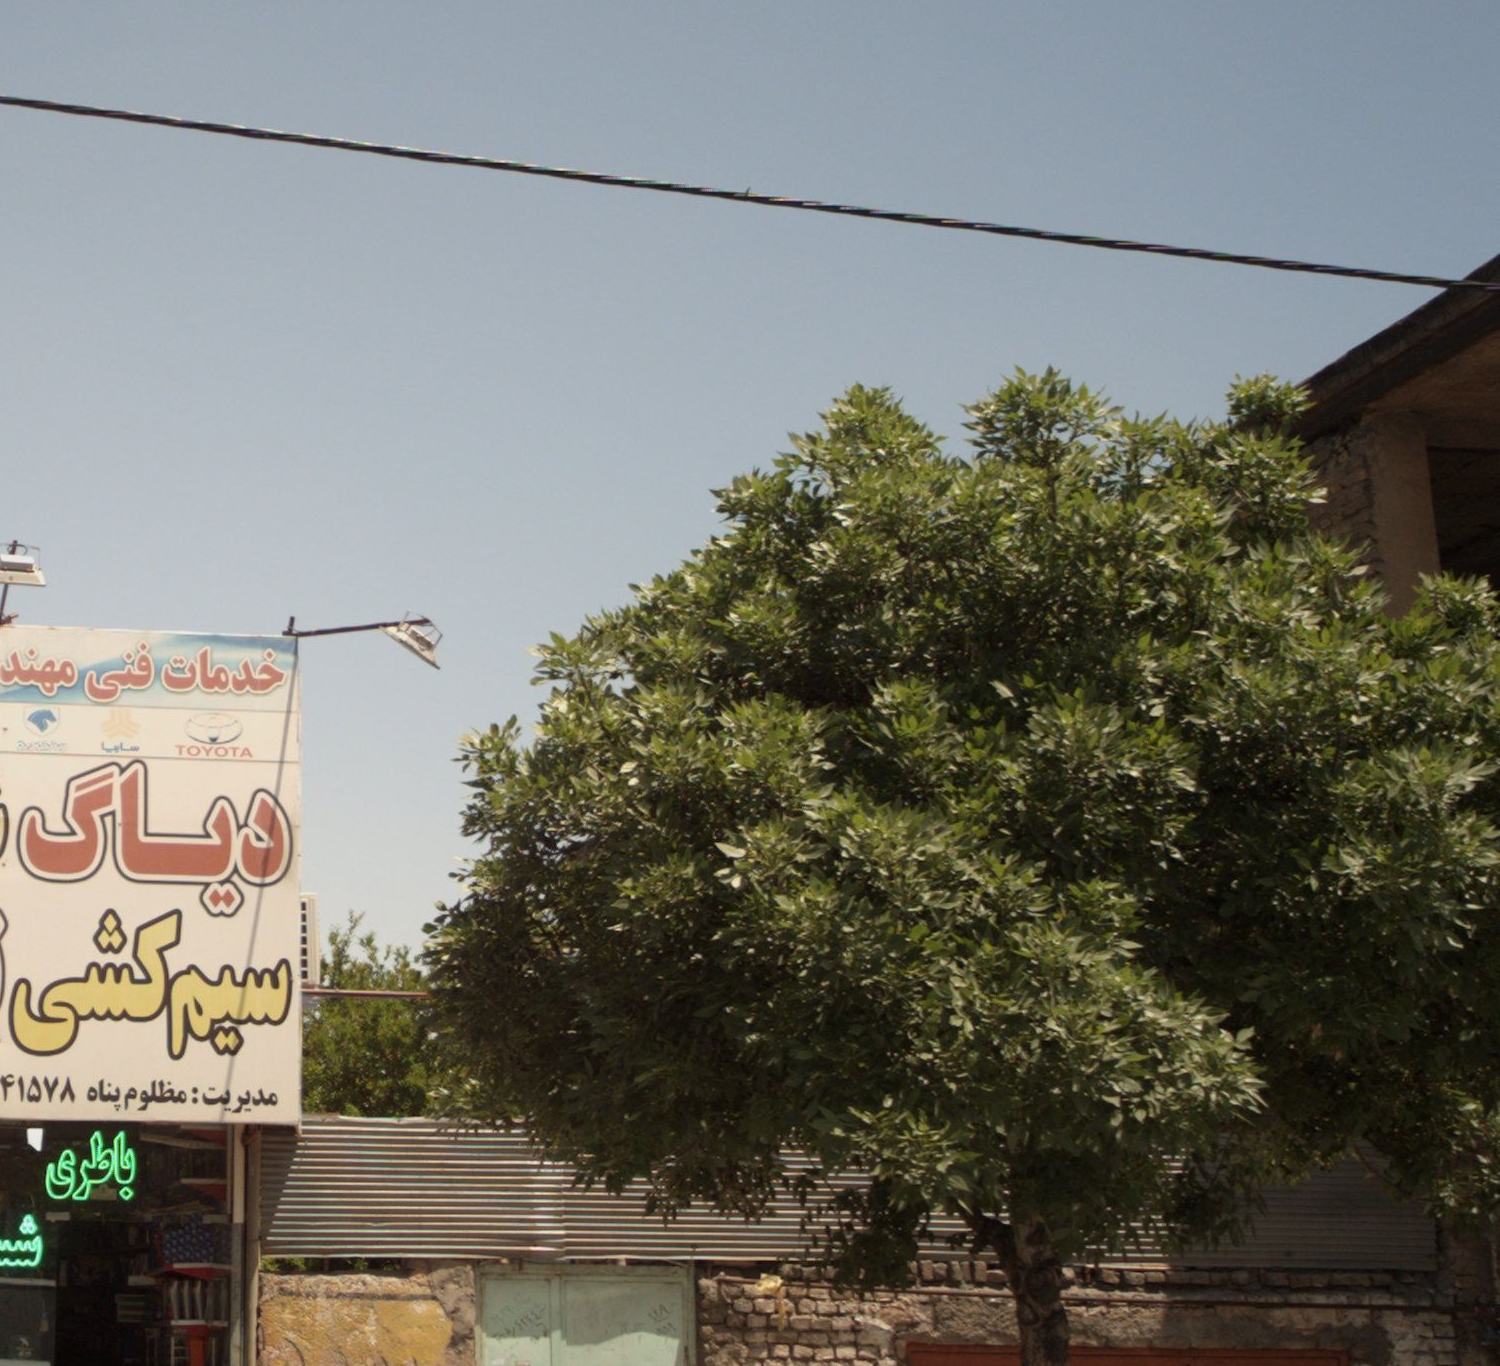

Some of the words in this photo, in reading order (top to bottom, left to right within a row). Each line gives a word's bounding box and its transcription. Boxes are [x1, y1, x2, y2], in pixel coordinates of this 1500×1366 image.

[85, 642, 154, 703] فنی
[162, 643, 287, 697] خدمات
[100, 741, 140, 754] سایپا
[175, 744, 254, 761] TOYOTA
[18, 758, 294, 918] دیاگ
[87, 1081, 122, 1111] پناه
[124, 1081, 188, 1109] مظلوم
[45, 1130, 137, 1202] باطری
